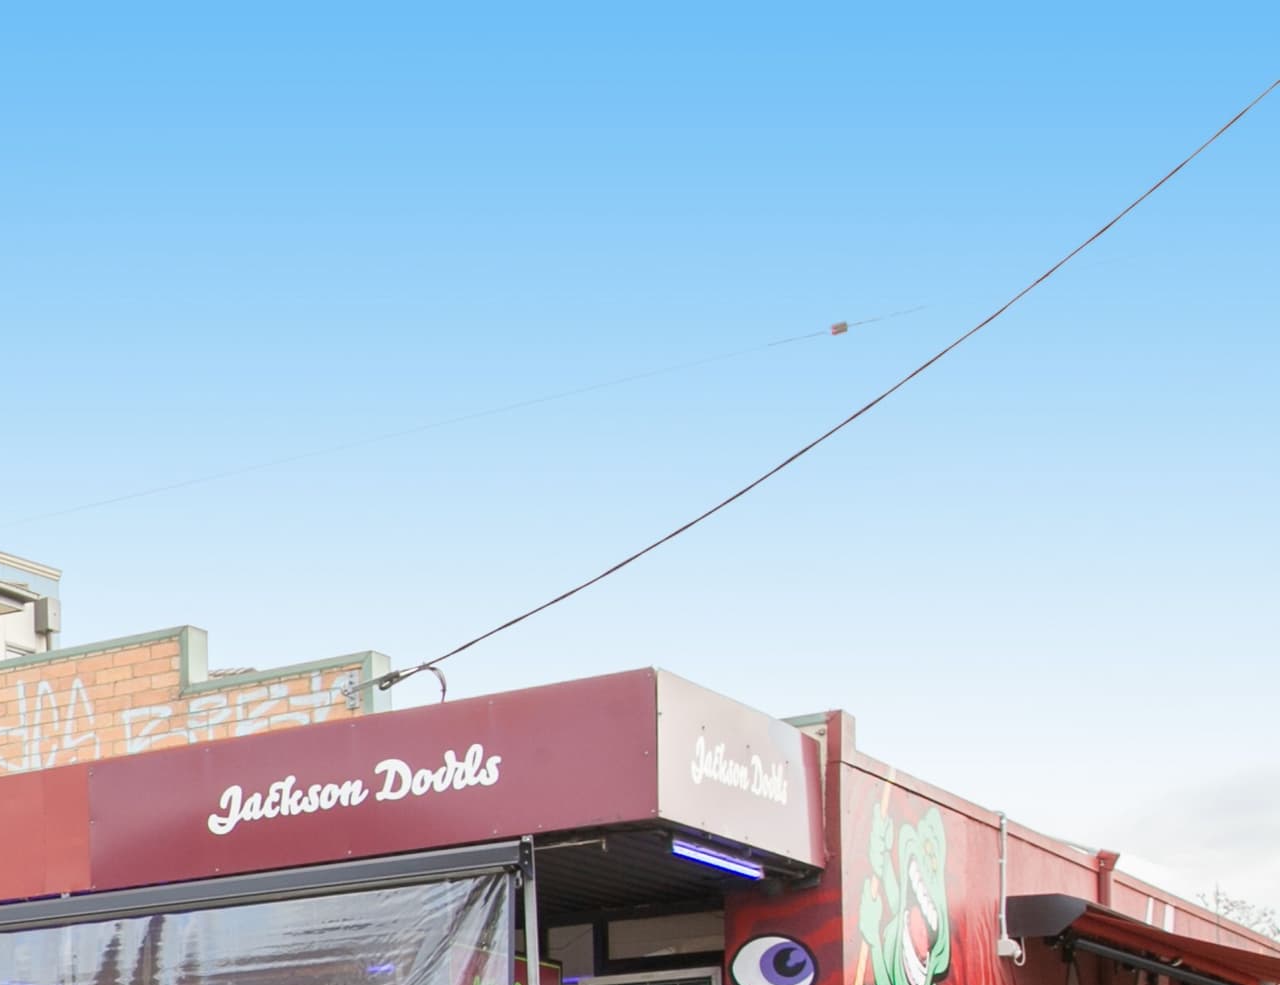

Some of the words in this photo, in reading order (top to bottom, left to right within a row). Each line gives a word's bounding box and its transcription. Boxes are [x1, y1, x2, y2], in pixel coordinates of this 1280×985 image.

[207, 774, 370, 836] Jackson
[374, 743, 502, 801] Dodds
[690, 735, 750, 791] Jackson
